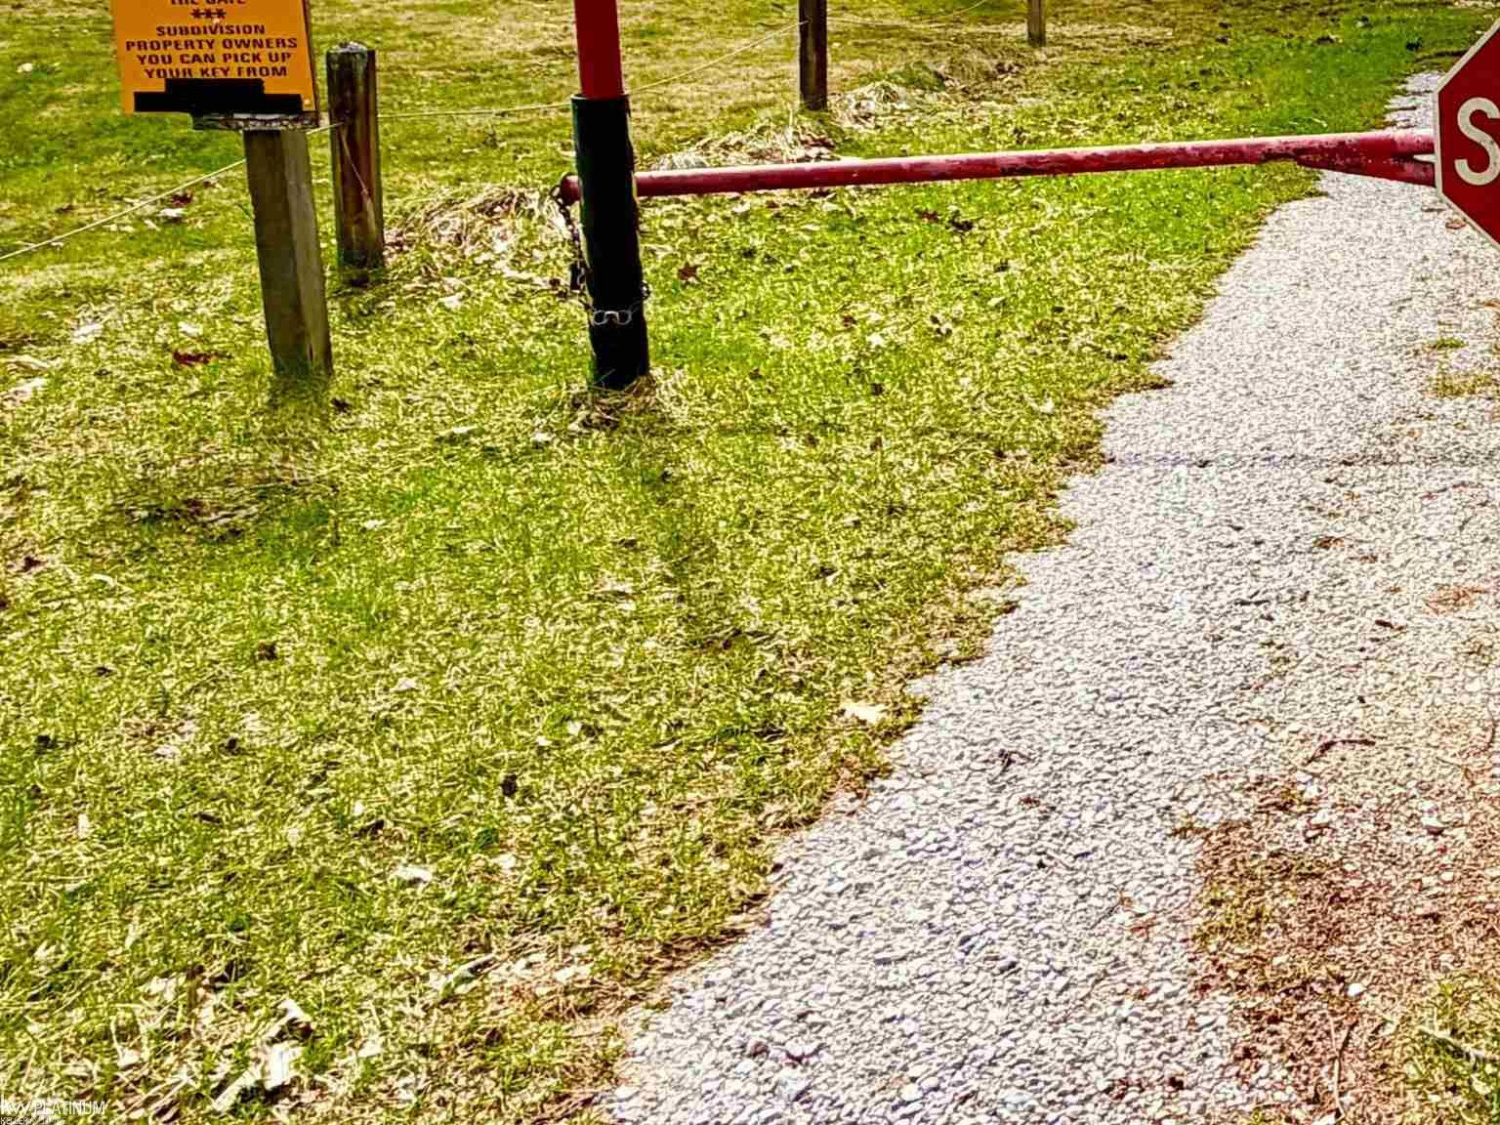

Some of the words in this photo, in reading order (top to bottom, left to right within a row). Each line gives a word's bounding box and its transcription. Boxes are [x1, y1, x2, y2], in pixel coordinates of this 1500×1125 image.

[155, 25, 265, 37] SUBDIVISION
[126, 39, 215, 52] PROPERTY
[222, 37, 298, 50] OWNERS
[137, 54, 172, 66] YOU
[180, 53, 216, 65] CAN
[222, 52, 262, 64] PICK
[268, 52, 292, 63] UP
[144, 68, 193, 79] YOUR
[200, 67, 231, 79] KEY
[237, 65, 288, 78] FROM
